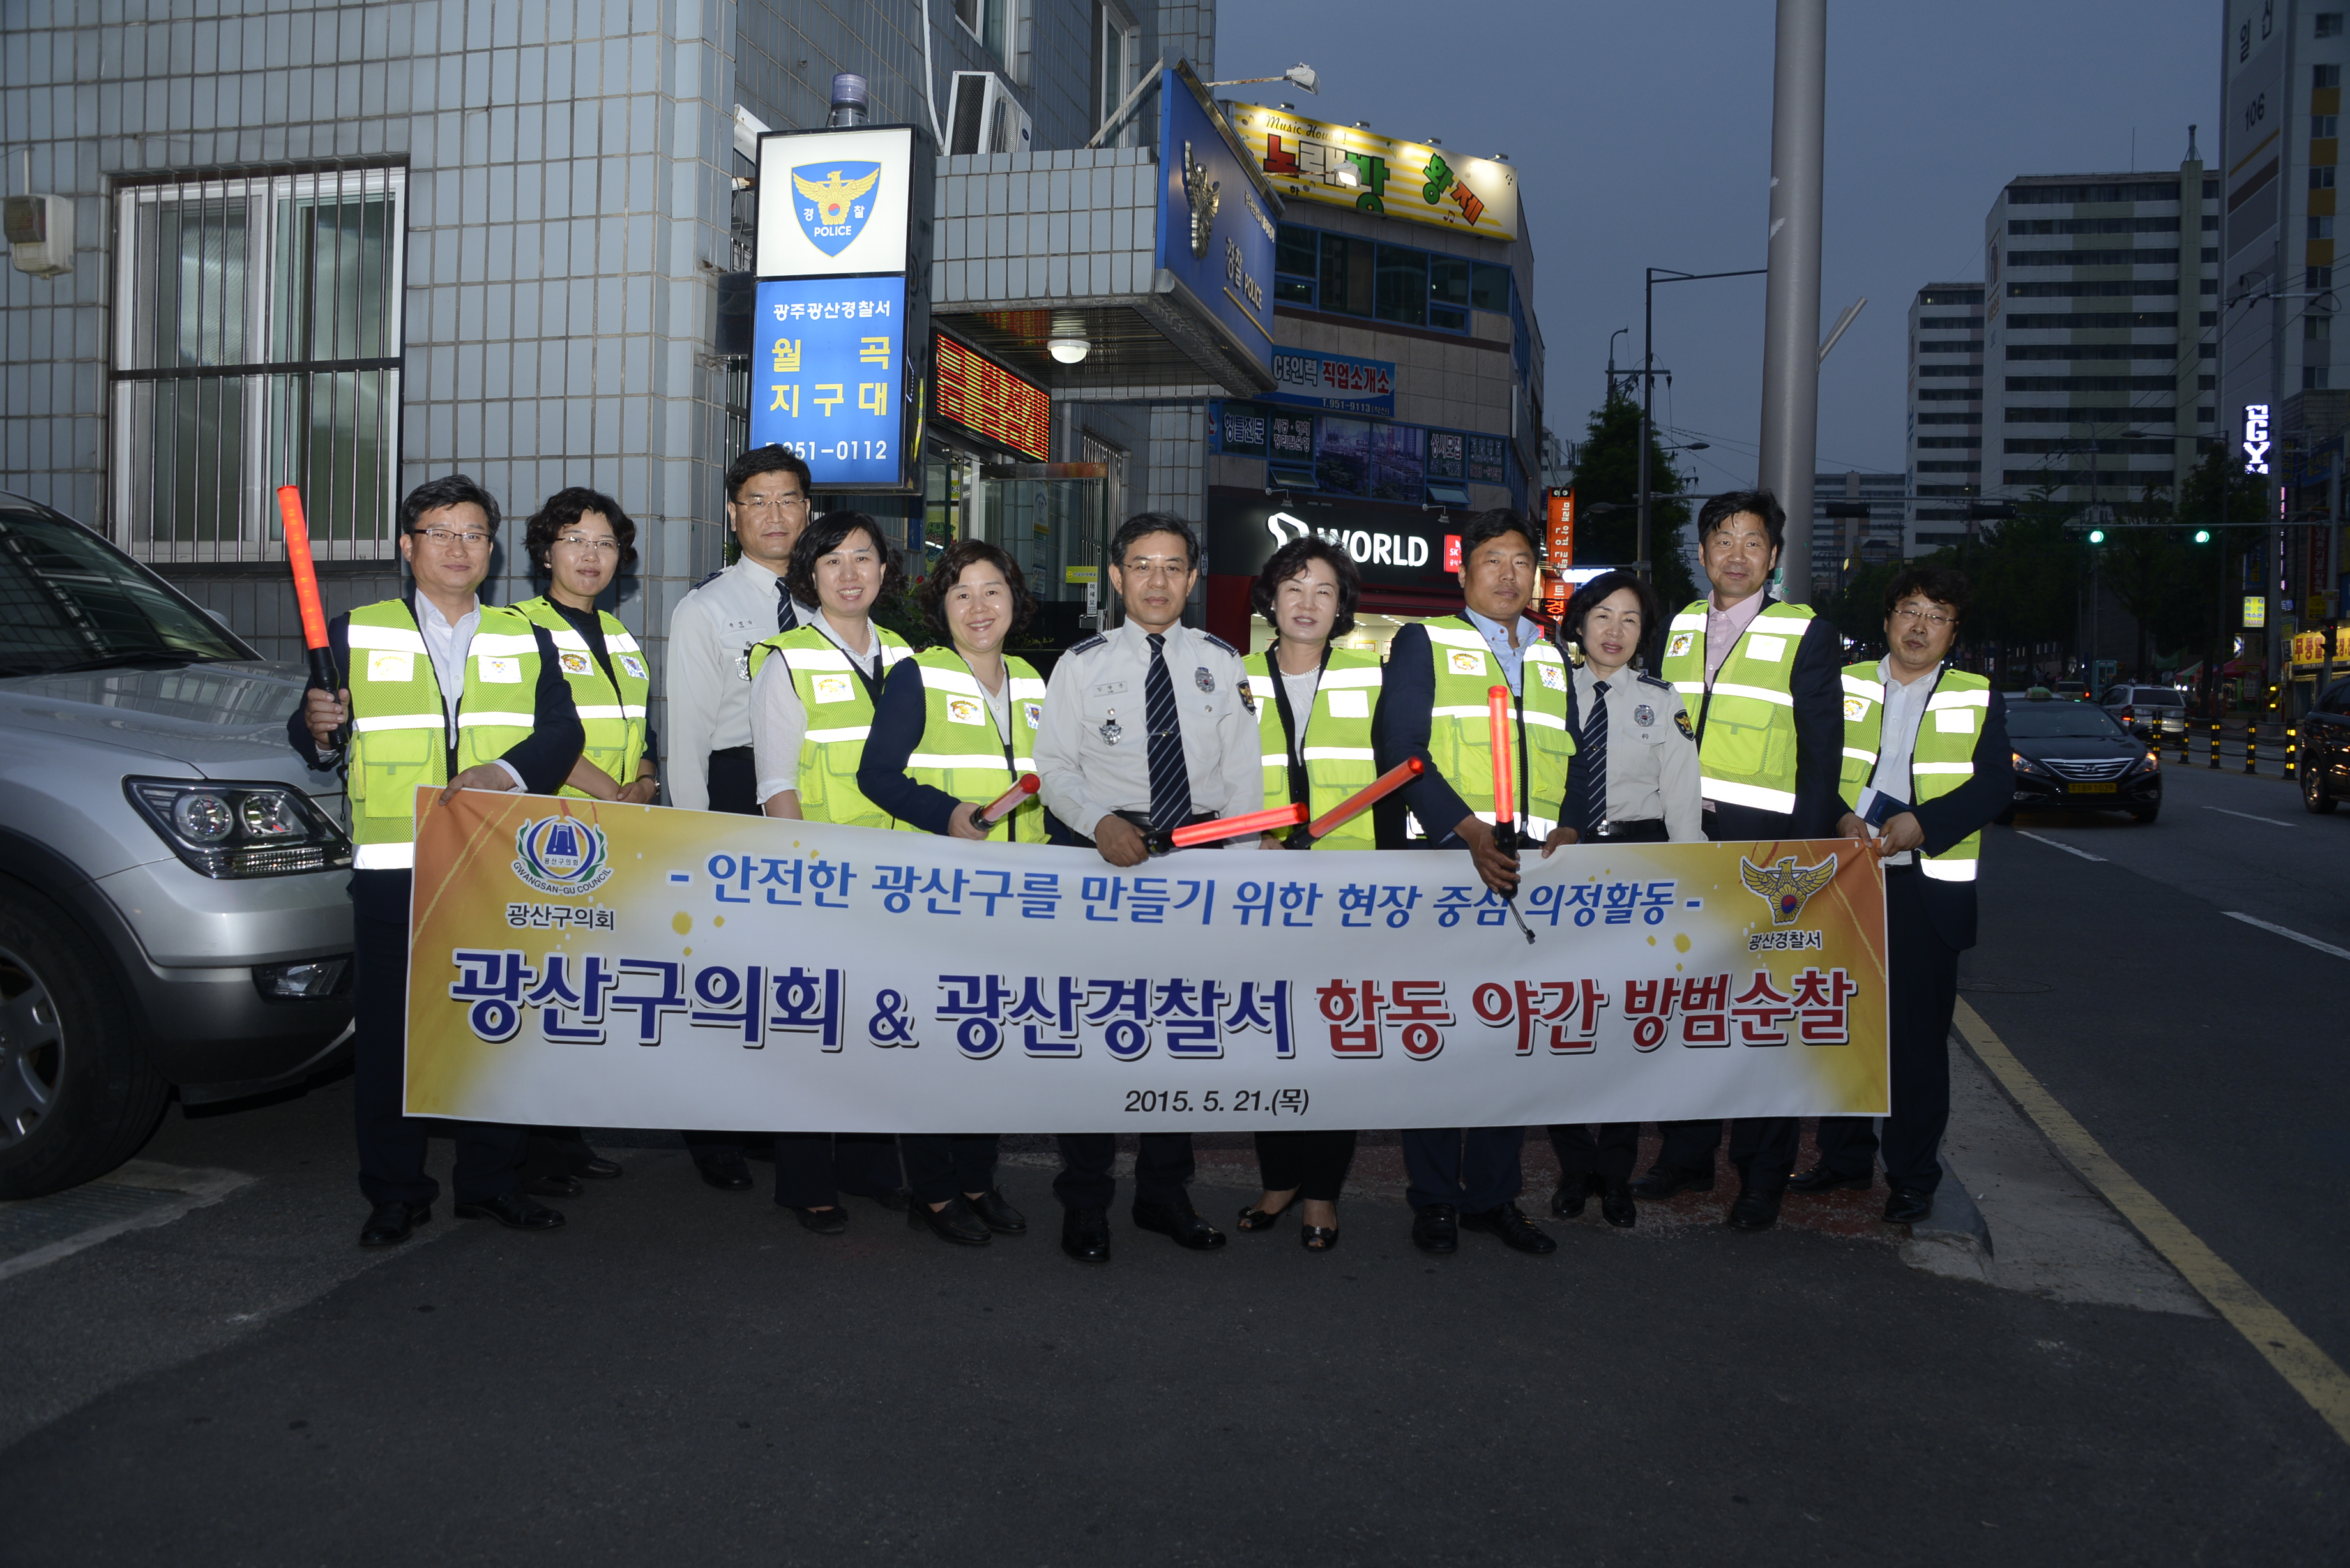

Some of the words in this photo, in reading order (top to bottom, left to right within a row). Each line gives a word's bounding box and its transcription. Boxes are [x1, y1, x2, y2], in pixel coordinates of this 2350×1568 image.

[2245, 93, 2264, 132] 106
[1264, 115, 1301, 135] Music
[1305, 124, 1340, 144] House
[1263, 133, 1390, 213] 노래방
[814, 225, 852, 237] POLICE
[1226, 236, 1243, 289] 경찰
[1244, 272, 1262, 311] POLICE
[773, 300, 891, 321] 광주광산경찰서
[1322, 360, 1390, 395] 직업소개소
[1323, 398, 1370, 412] T.951-9113
[1224, 413, 1264, 444] 형틀전문
[1273, 434, 1310, 453] 정리팀운영
[1430, 433, 1462, 460] 상시모집
[1430, 458, 1461, 473] 951-9113
[1561, 502, 1570, 522] 미래
[1555, 525, 1570, 546] 안경
[1449, 548, 1459, 556] SK
[544, 857, 579, 866] 광산구의회
[513, 862, 575, 894] GWANGSAN-GU
[577, 868, 611, 893] COUNCIL
[708, 854, 857, 909] 안전한
[872, 865, 1062, 919] 광산구를
[1081, 876, 1215, 926] 만들기
[1232, 881, 1323, 927] 위한
[1338, 883, 1422, 930] 현장
[1433, 884, 1510, 928] 중심
[508, 905, 614, 931] 광산구의회
[1748, 931, 1821, 950] 광산경찰서
[451, 951, 843, 1050] 광산구의회
[868, 989, 915, 1044] &
[936, 974, 1291, 1057] 광산경찰서
[1317, 978, 1451, 1057] 합동
[1473, 978, 1604, 1052] 야간
[1624, 969, 1854, 1048] 방범순찰
[1125, 1090, 1194, 1112] 2015.
[1203, 1091, 1224, 1112] 5.
